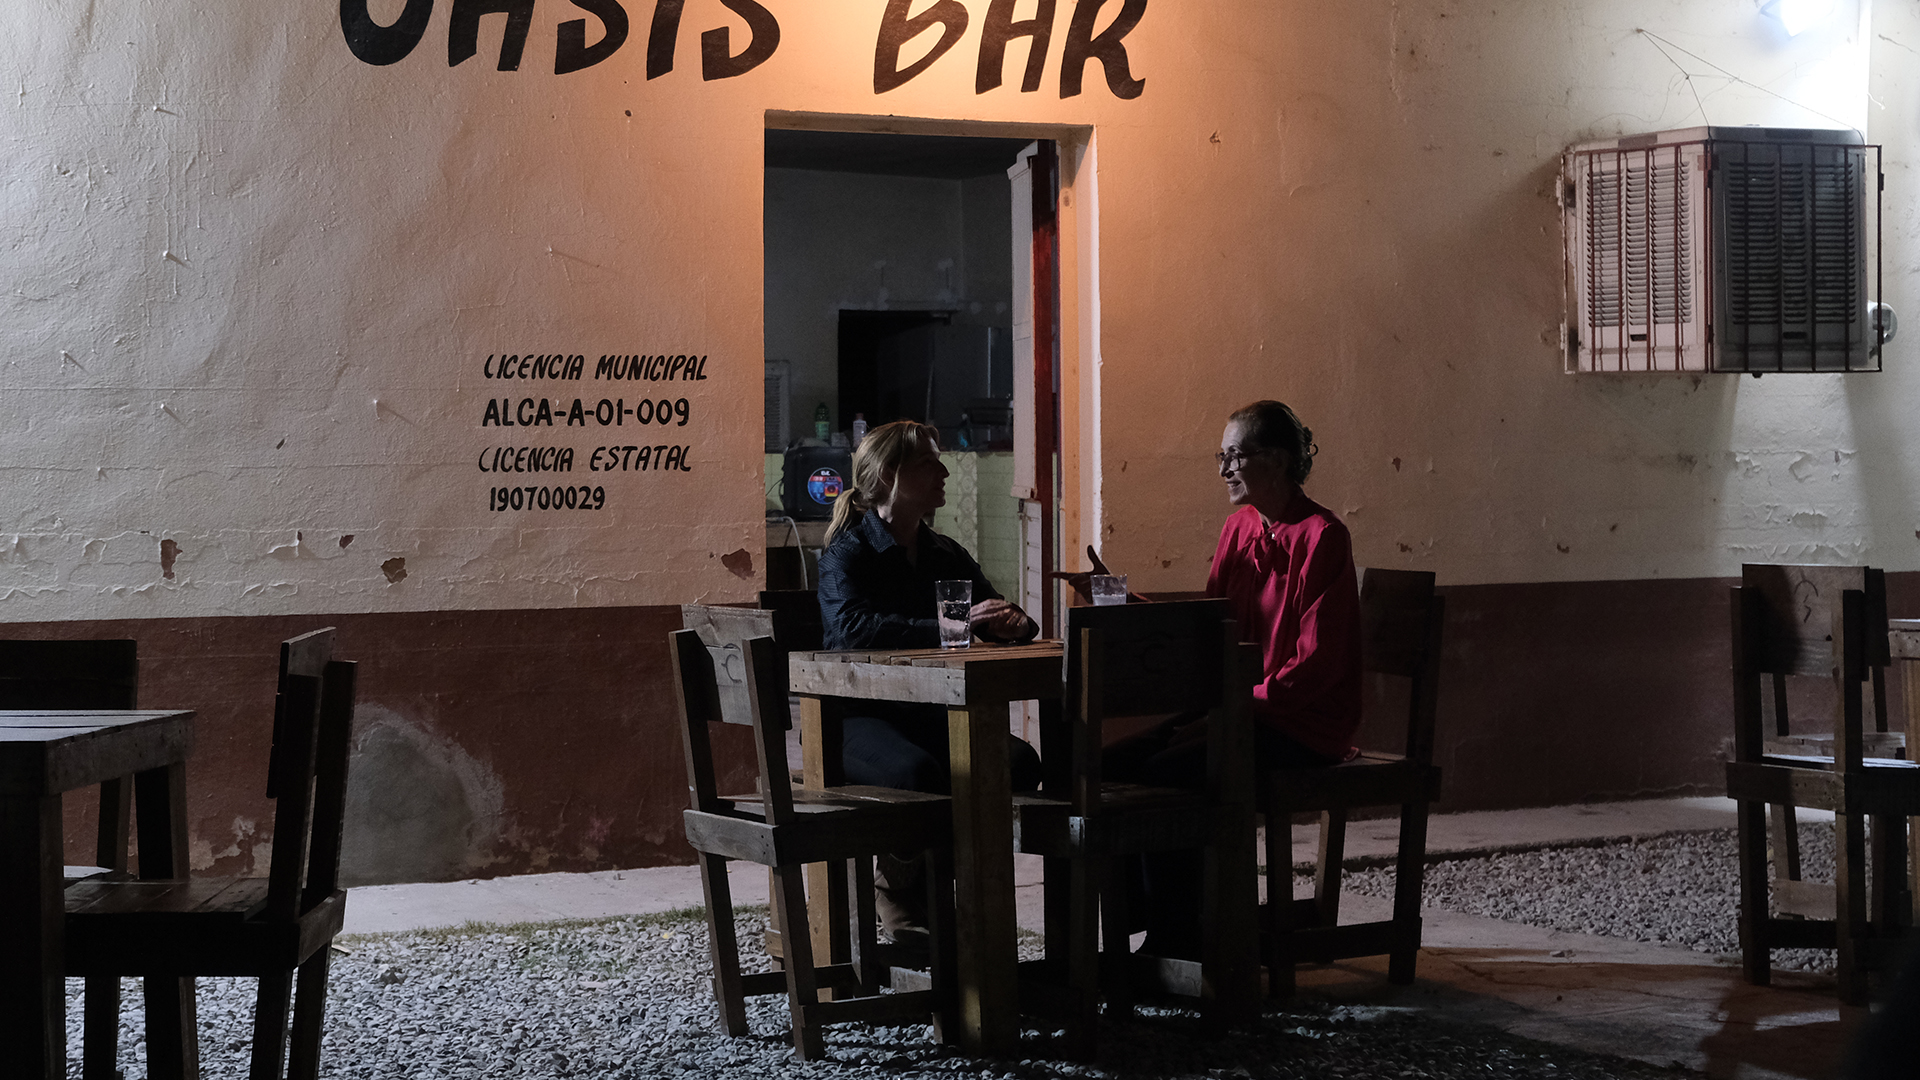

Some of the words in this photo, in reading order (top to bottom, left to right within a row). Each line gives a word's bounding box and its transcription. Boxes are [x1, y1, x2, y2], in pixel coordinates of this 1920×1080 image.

[873, 0, 1148, 100] BAR
[483, 354, 585, 381] LICENCIA
[594, 354, 708, 382] MUNICIPAL
[482, 397, 690, 427] ALCA-A-01-009
[478, 446, 575, 473] LICENCIA
[589, 445, 692, 473] ESTATAL
[489, 485, 606, 512] 190700029
